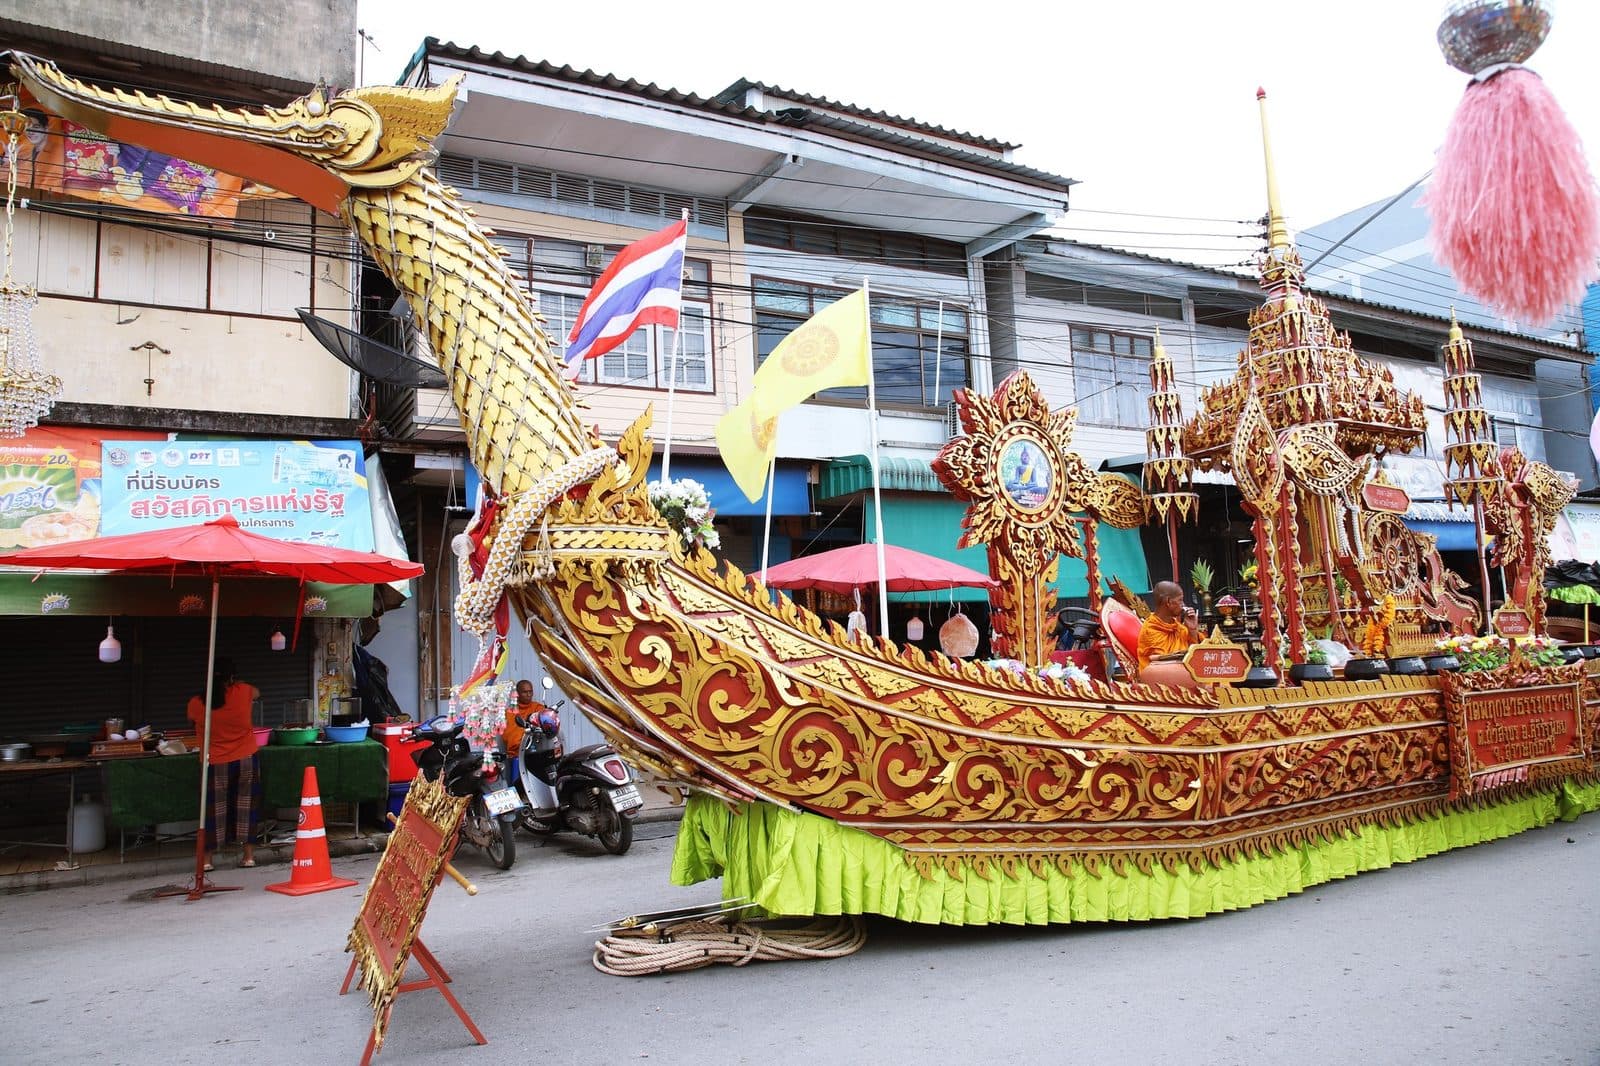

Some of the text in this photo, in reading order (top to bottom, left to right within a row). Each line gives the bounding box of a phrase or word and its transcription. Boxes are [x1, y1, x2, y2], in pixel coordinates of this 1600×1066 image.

[127, 470, 220, 490] ที่นี่รับบัตร
[131, 487, 345, 518] สวัสดิการแห่งรัฐ
